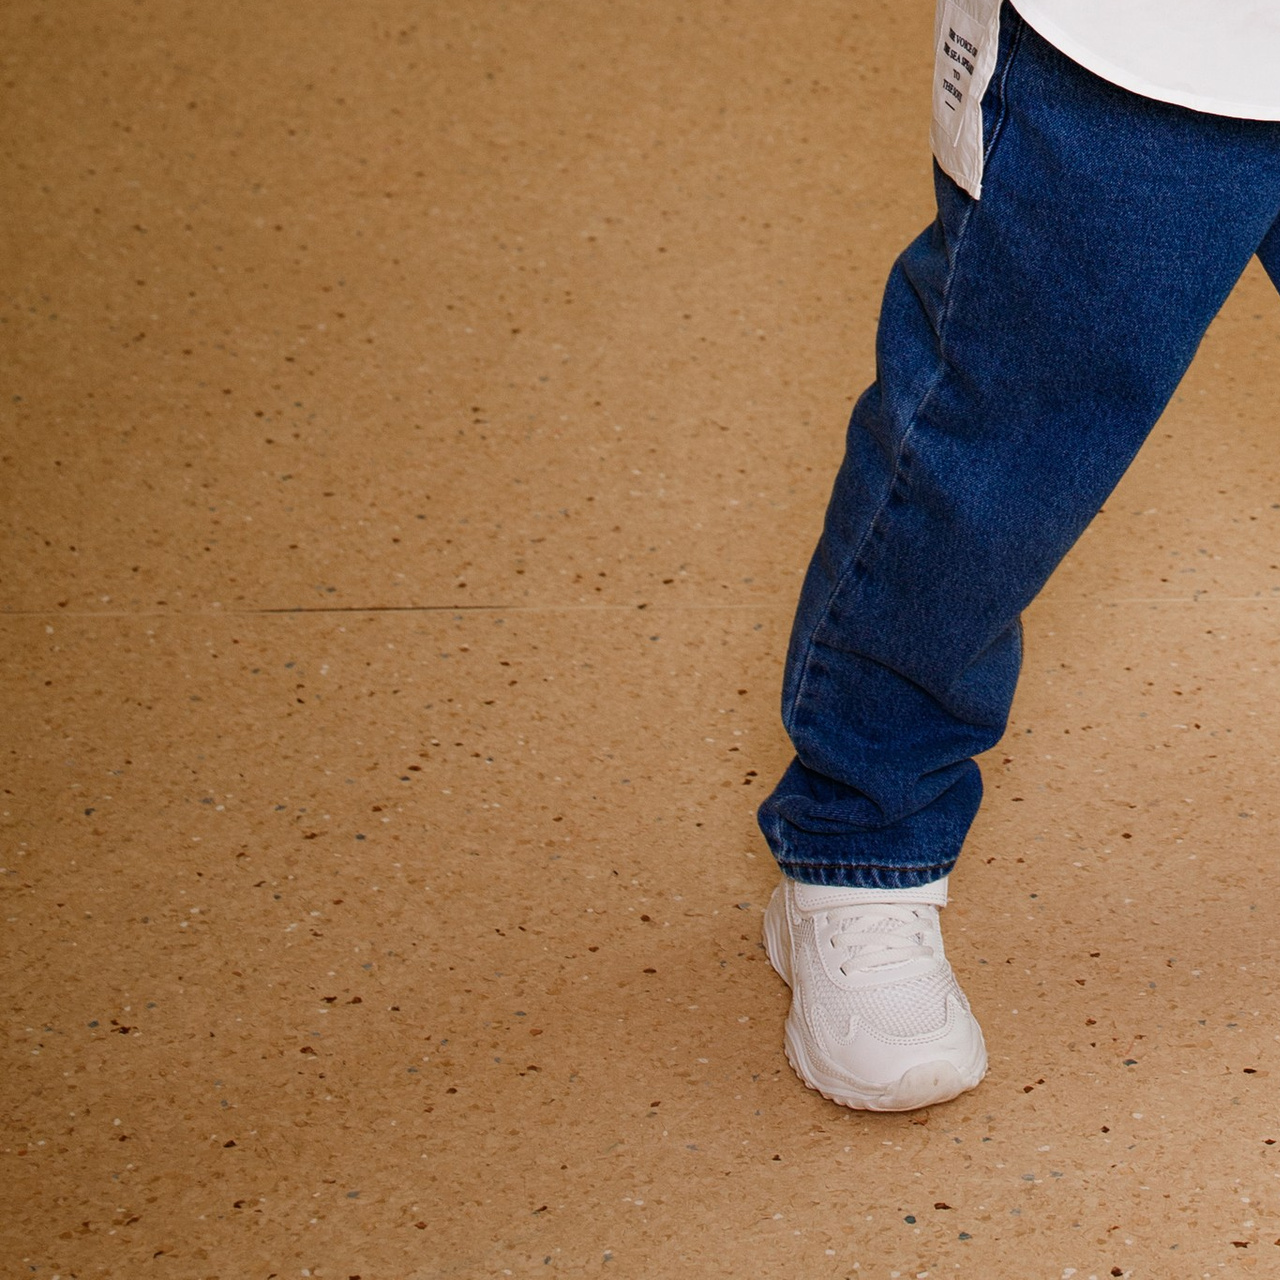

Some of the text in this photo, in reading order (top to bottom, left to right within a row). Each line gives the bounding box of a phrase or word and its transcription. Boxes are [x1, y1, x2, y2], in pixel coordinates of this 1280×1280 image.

[956, 34, 973, 54] VOICE
[950, 49, 961, 64] SEA
[953, 68, 961, 81] TO
[943, 78, 953, 92] THE
